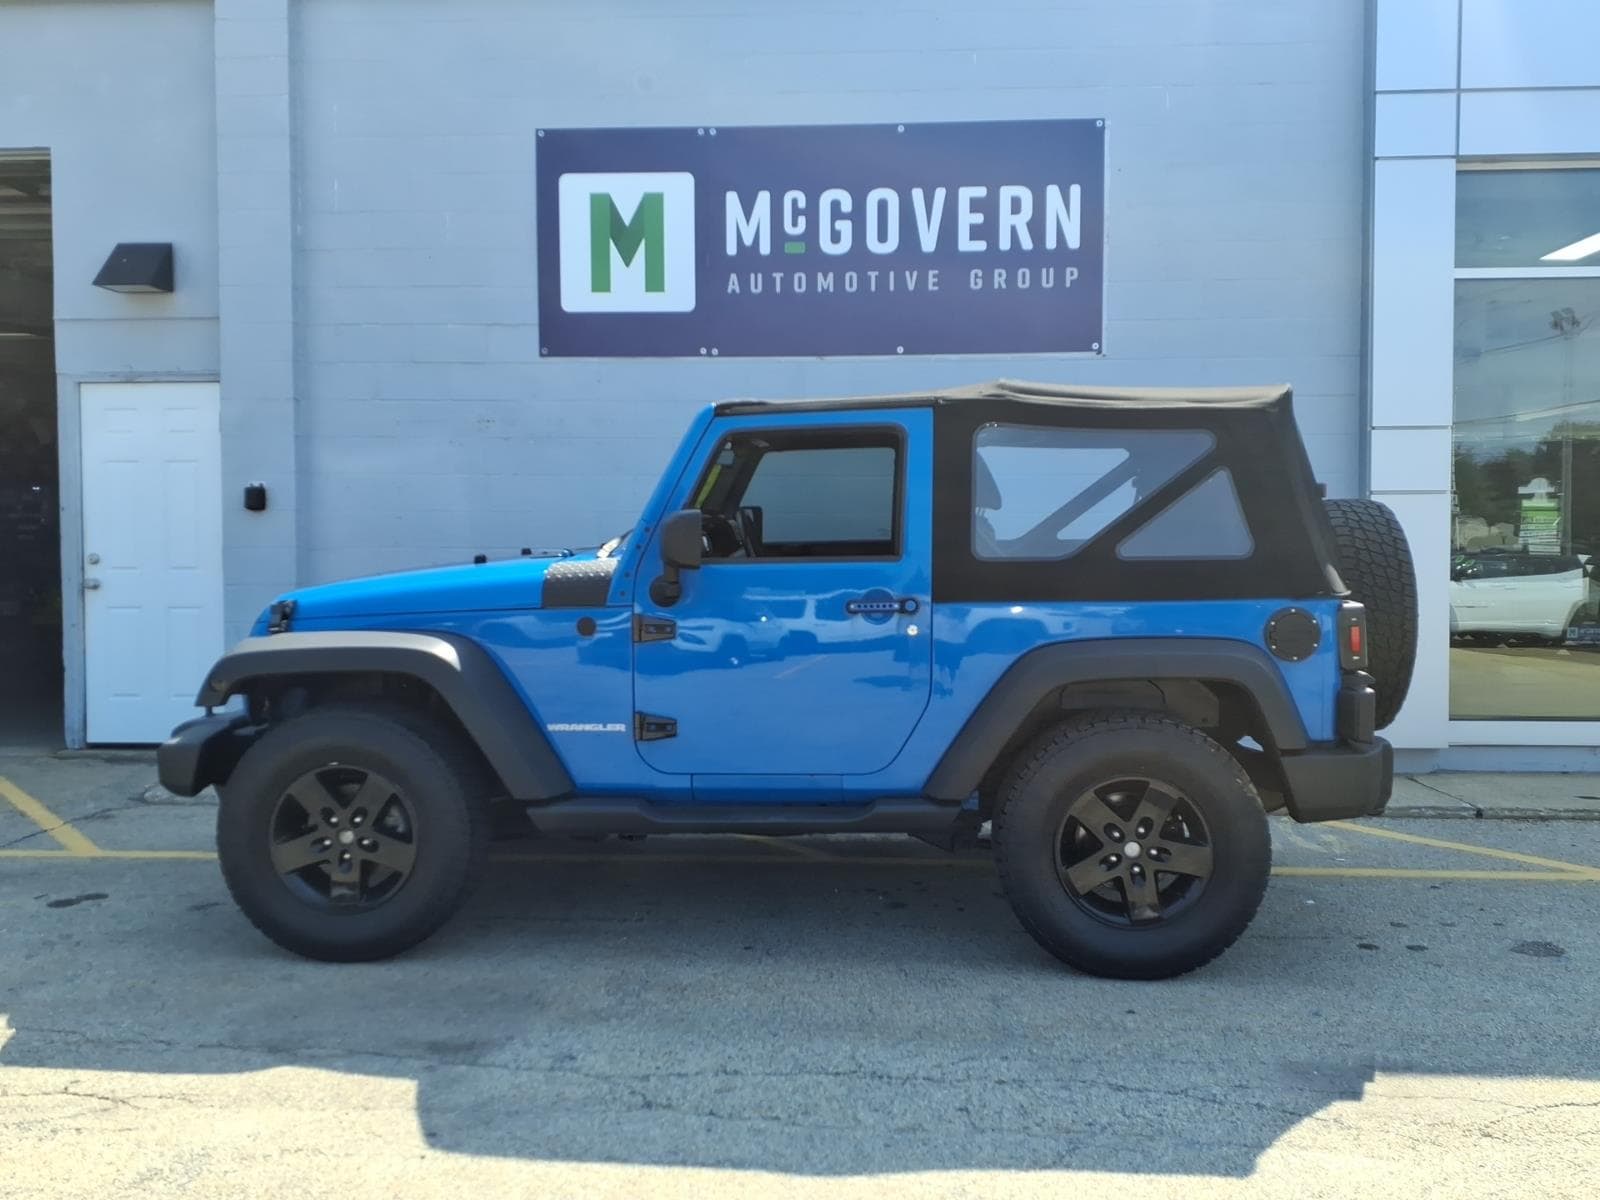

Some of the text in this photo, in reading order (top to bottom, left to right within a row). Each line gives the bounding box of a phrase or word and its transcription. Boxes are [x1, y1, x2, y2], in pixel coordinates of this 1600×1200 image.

[590, 192, 665, 293] M
[726, 266, 1080, 294] AUTOMOTIVE GROUP
[546, 723, 626, 732] WRANGLER
